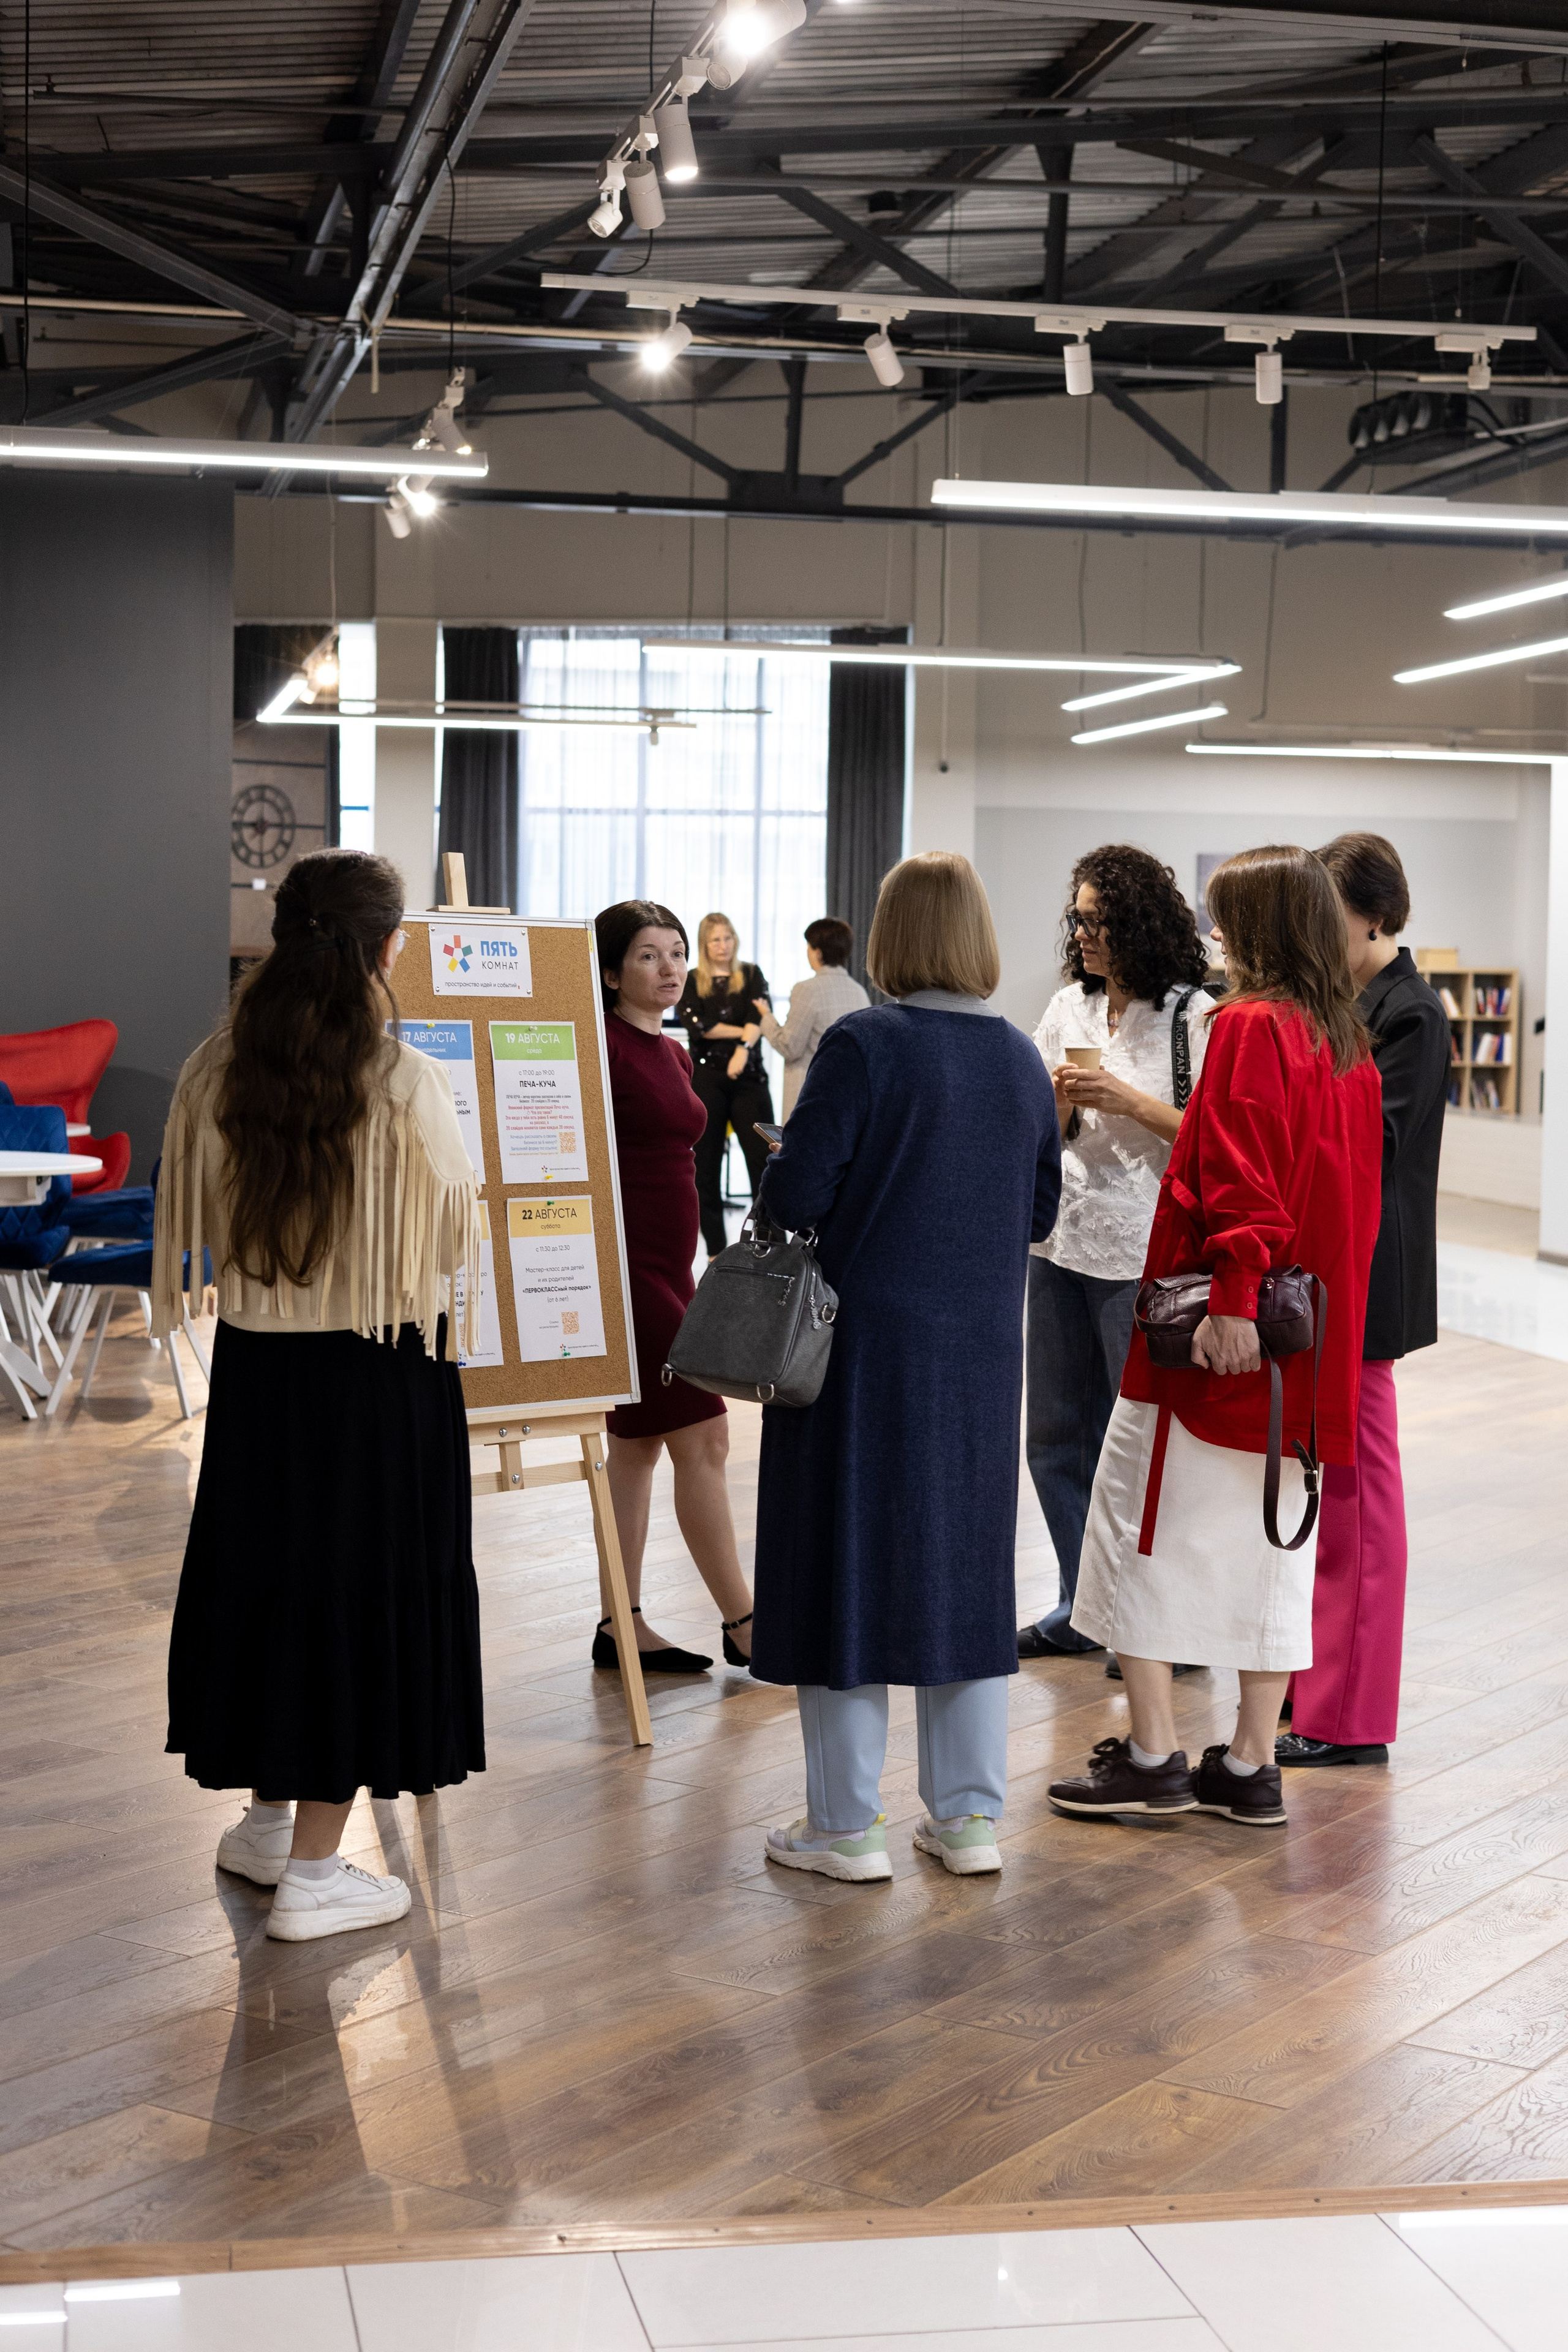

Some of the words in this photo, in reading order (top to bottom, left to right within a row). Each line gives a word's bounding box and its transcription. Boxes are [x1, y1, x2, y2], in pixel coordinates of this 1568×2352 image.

[480, 941, 518, 956] ПЯТЬ
[482, 961, 518, 970] КОМНАТ
[402, 1031, 411, 1042] 17
[413, 1032, 457, 1042] АВГУСТА
[505, 1033, 515, 1043] 19
[518, 1033, 560, 1043] АВГУСТА
[522, 1210, 532, 1219] 22
[535, 1208, 577, 1219] АВГУСТА
